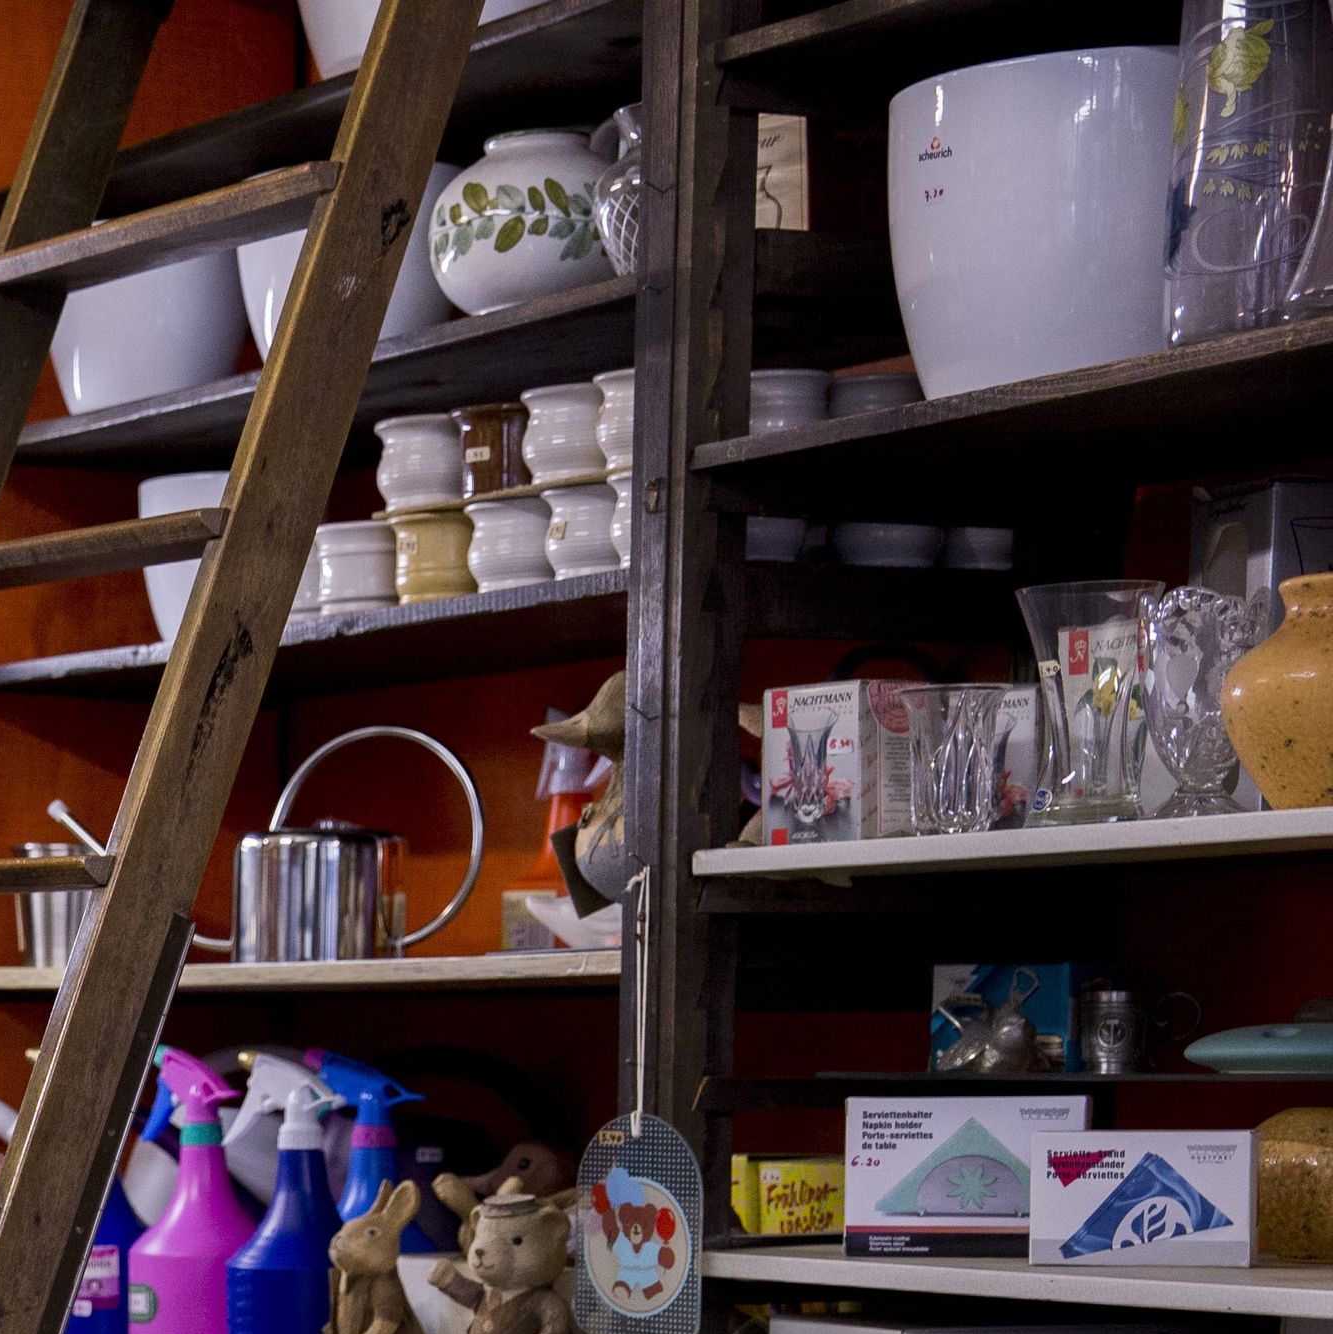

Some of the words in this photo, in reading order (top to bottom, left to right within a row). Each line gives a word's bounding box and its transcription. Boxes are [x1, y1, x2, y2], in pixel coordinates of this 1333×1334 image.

[918, 146, 953, 162] scheurich
[789, 692, 853, 708] NACHTMANN
[862, 1110, 933, 1120] Serviettenhalter
[862, 1121, 893, 1130] Napkin
[894, 1121, 923, 1130] holder
[861, 1141, 873, 1150] de
[875, 1141, 897, 1150] table
